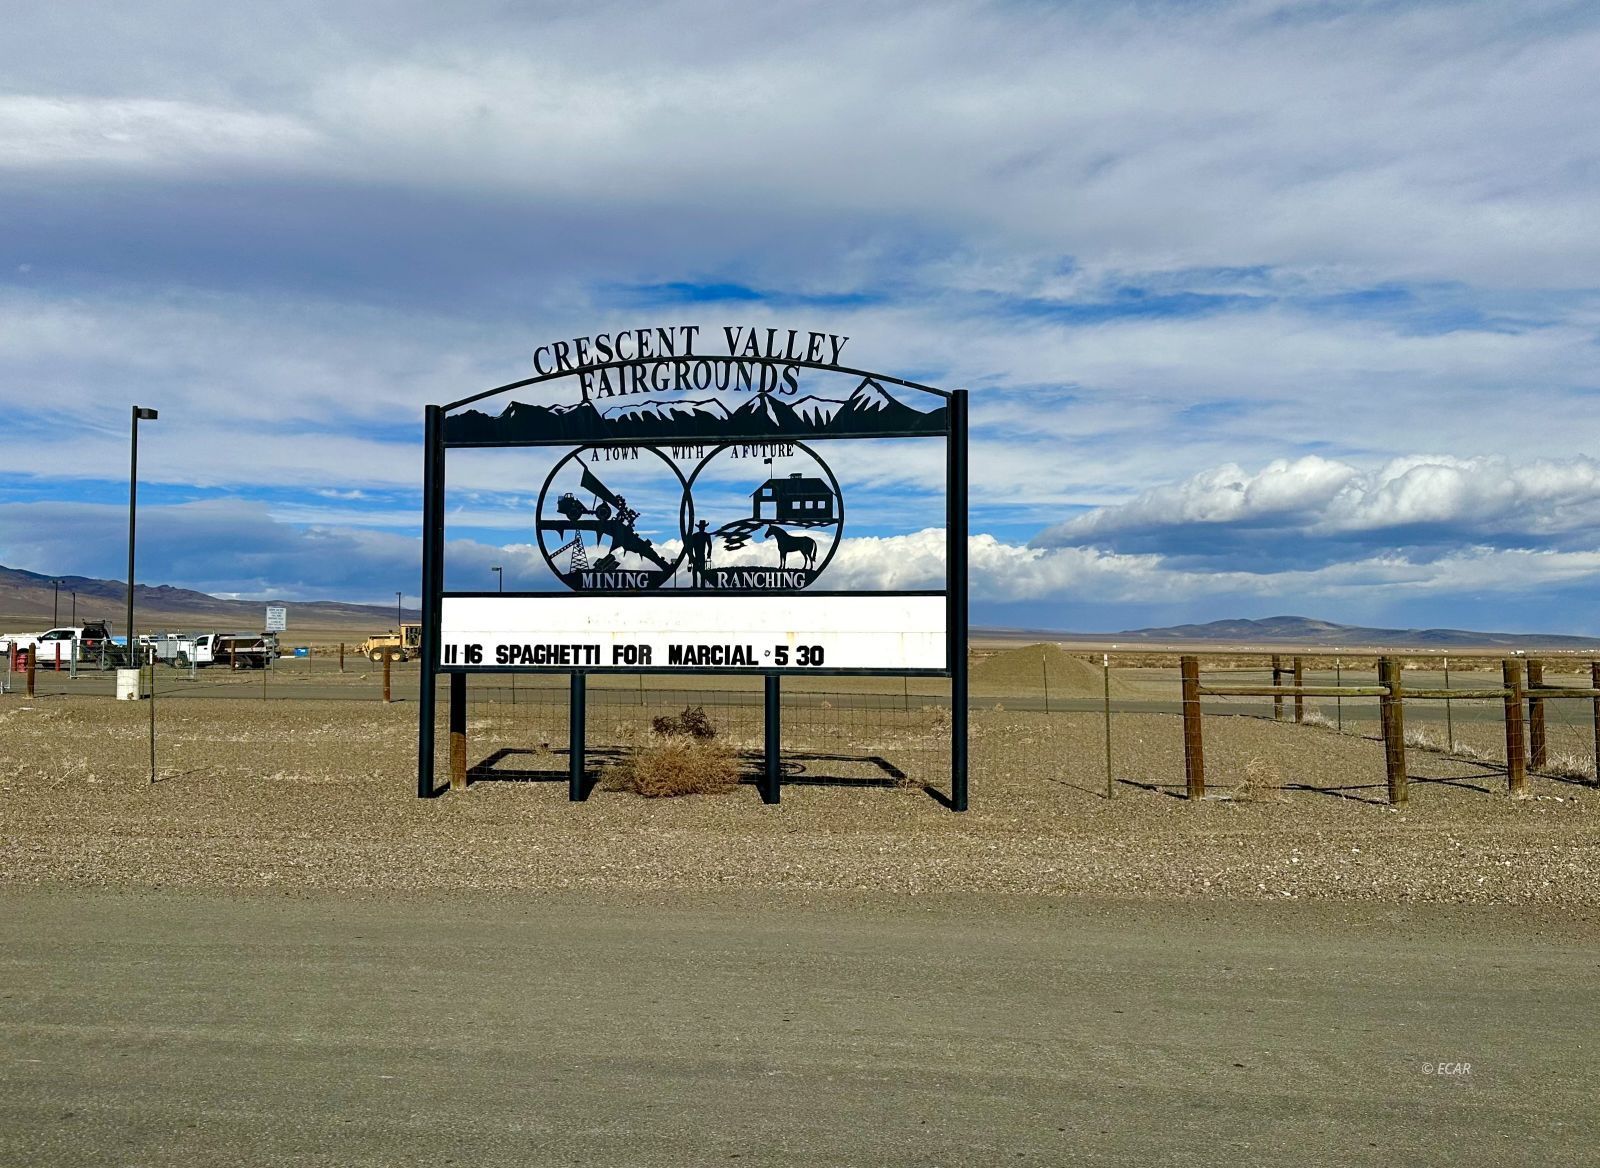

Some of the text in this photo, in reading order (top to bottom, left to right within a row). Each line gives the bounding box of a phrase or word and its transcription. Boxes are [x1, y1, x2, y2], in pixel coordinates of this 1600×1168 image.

[533, 326, 850, 375] CRESCENT VALLEY
[579, 360, 800, 402] FAIRGROUNDS
[591, 444, 794, 462] A TOWN WITH A FUTURE
[582, 572, 649, 589] MINING
[717, 571, 806, 589] RANCHING
[496, 644, 601, 665] SPAGHETTI
[612, 644, 652, 665] FOR
[668, 644, 759, 666] MARCIAL
